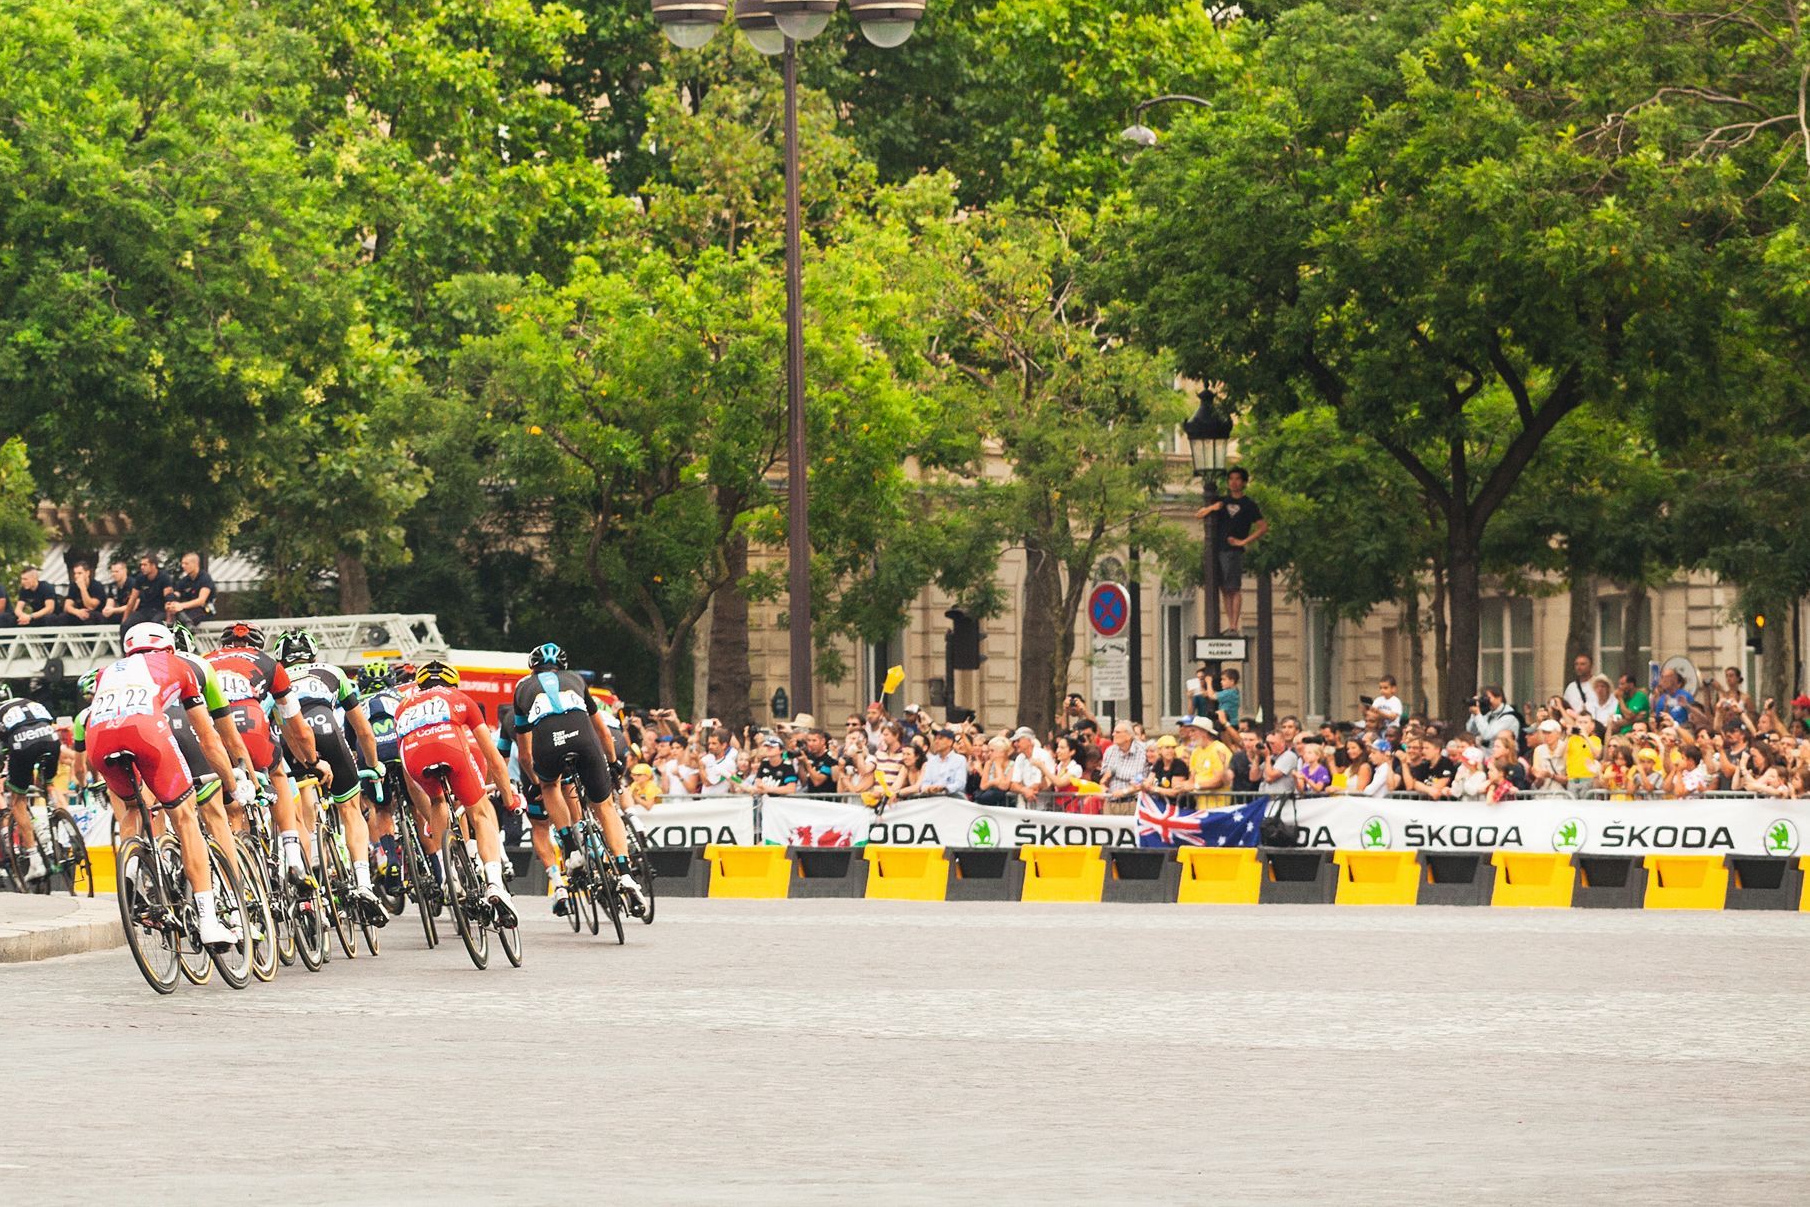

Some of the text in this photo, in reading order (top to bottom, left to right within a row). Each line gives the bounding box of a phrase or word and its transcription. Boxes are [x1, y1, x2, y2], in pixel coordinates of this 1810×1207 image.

[222, 676, 248, 693] 143
[96, 694, 115, 714] 22
[126, 689, 147, 707] 22
[535, 701, 541, 714] 6
[14, 725, 55, 742] wemo
[416, 723, 452, 737] Cofidis
[646, 826, 738, 848] KODA
[869, 823, 940, 845] ODA
[1014, 820, 1137, 847] ŠKODA
[1404, 819, 1524, 848] ŠKODA
[1600, 820, 1736, 849] ŠKODA
